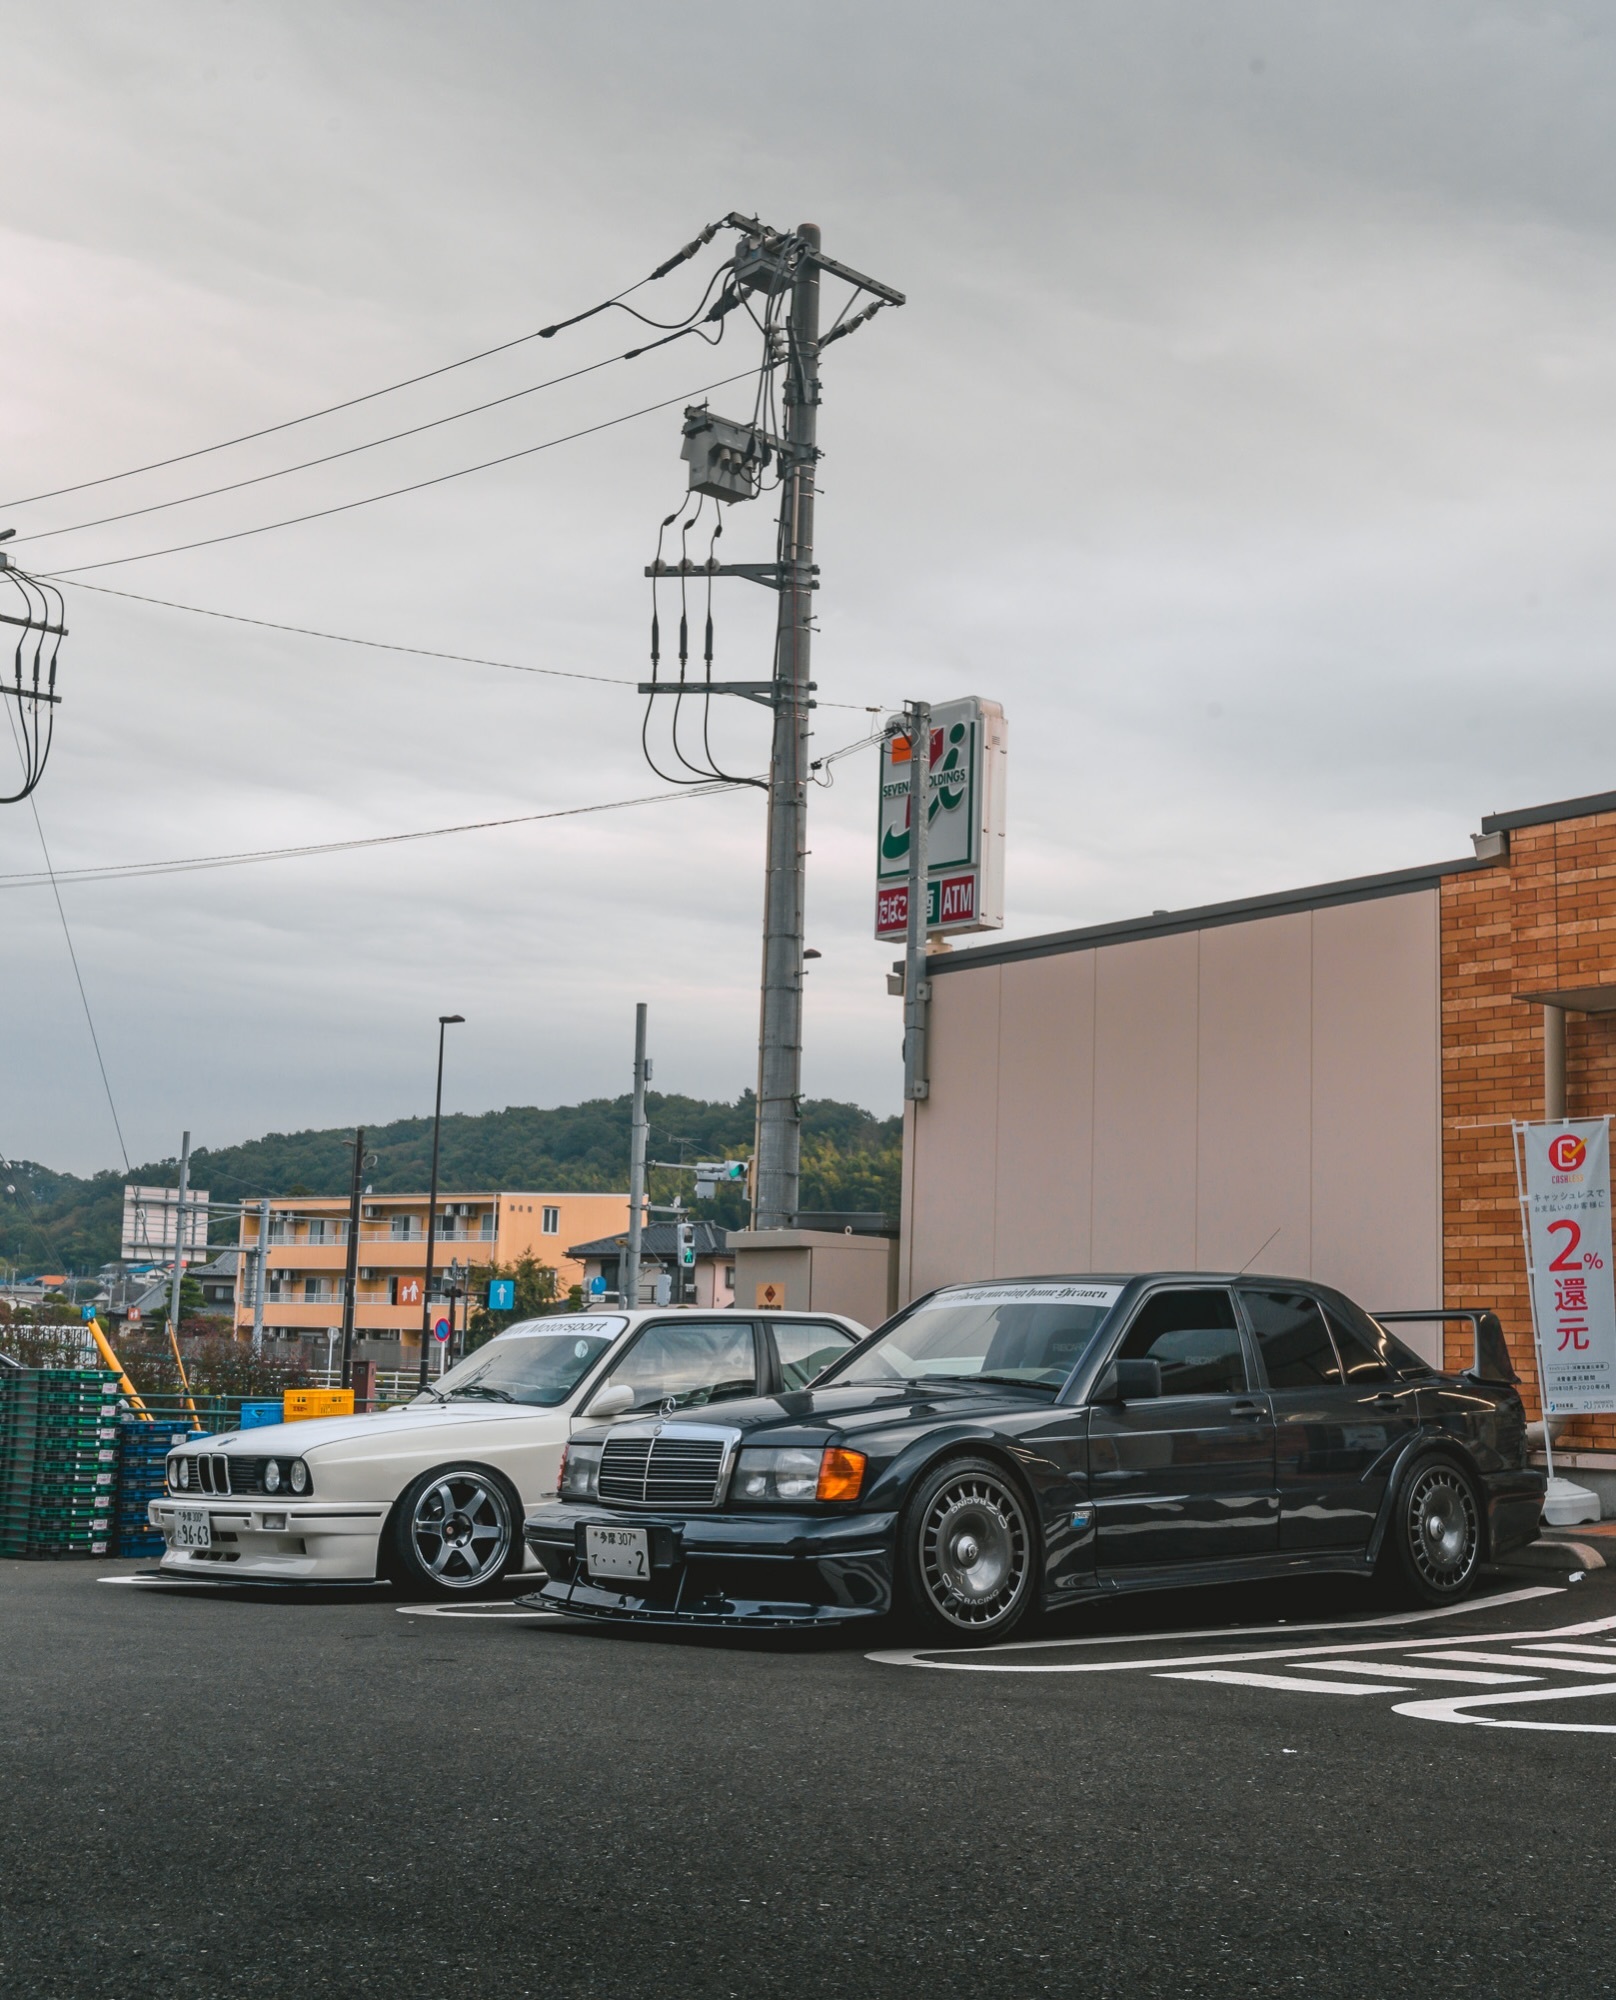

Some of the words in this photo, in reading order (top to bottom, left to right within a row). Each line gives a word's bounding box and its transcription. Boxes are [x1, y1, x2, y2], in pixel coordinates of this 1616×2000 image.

[883, 781, 911, 797] SEVEN
[928, 768, 965, 788] OLDINGS
[942, 883, 972, 915] ATM
[879, 894, 908, 925] たばこ
[1551, 1174, 1584, 1184] CASHLESS
[1534, 1189, 1605, 1202] キャッシュレスで
[1534, 1201, 1605, 1213] お支払いのお客様に
[1554, 1278, 1590, 1351] 還元
[527, 1321, 608, 1334] Motorsport
[963, 1588, 999, 1606] RACING
